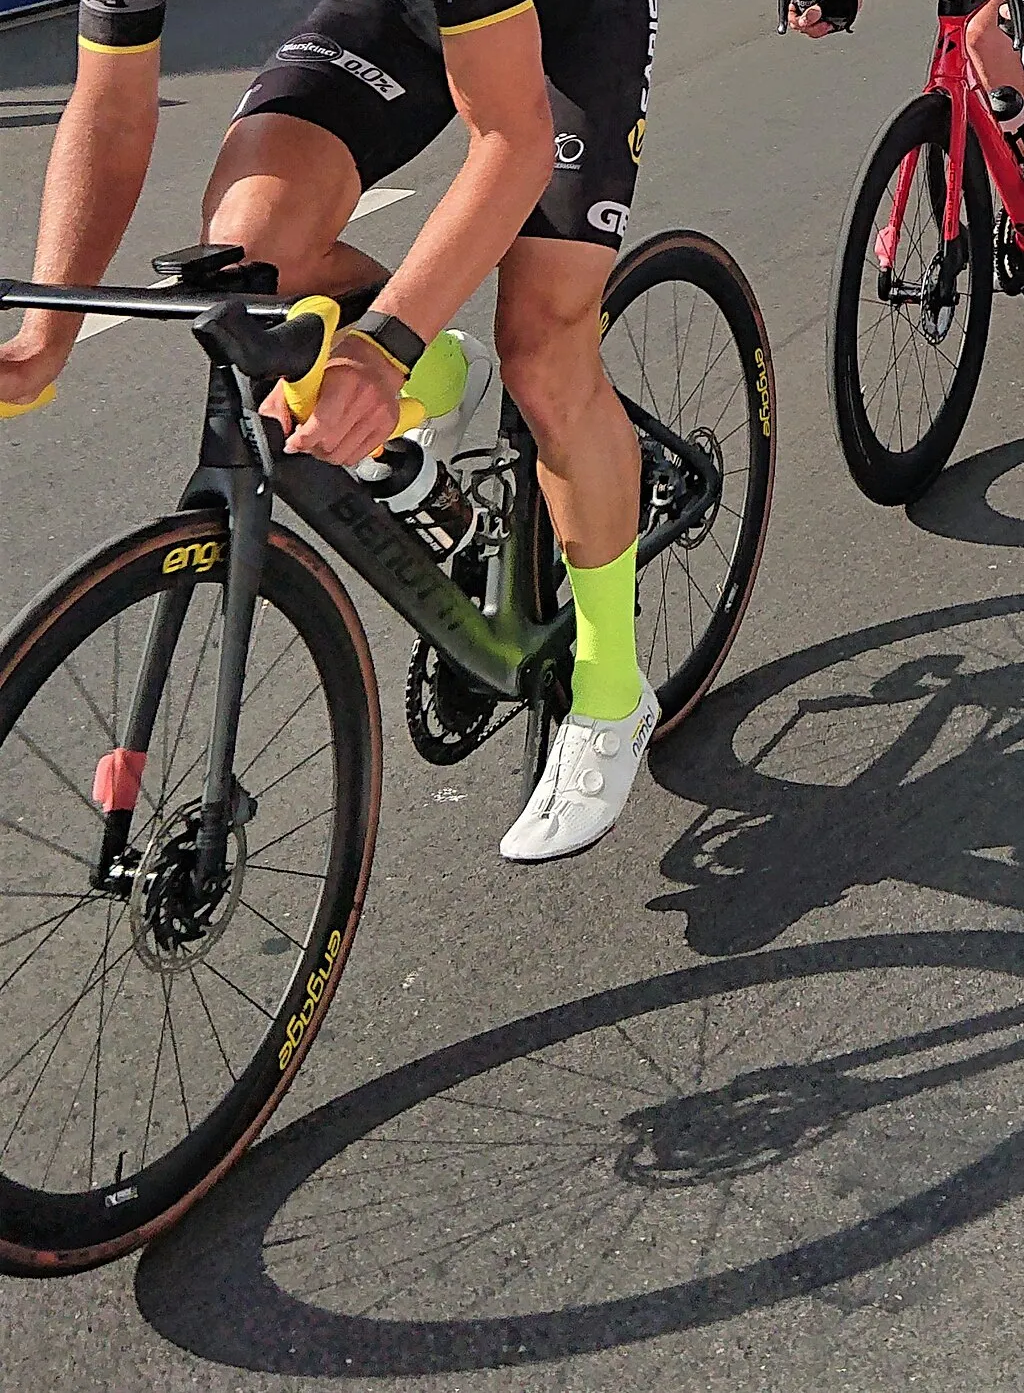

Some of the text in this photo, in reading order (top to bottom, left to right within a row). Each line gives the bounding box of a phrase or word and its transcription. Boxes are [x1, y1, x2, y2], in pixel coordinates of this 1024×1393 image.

[754, 347, 771, 437] engage
[162, 541, 222, 575] eng
[632, 705, 656, 758] nimbl
[278, 929, 341, 1071] engage
